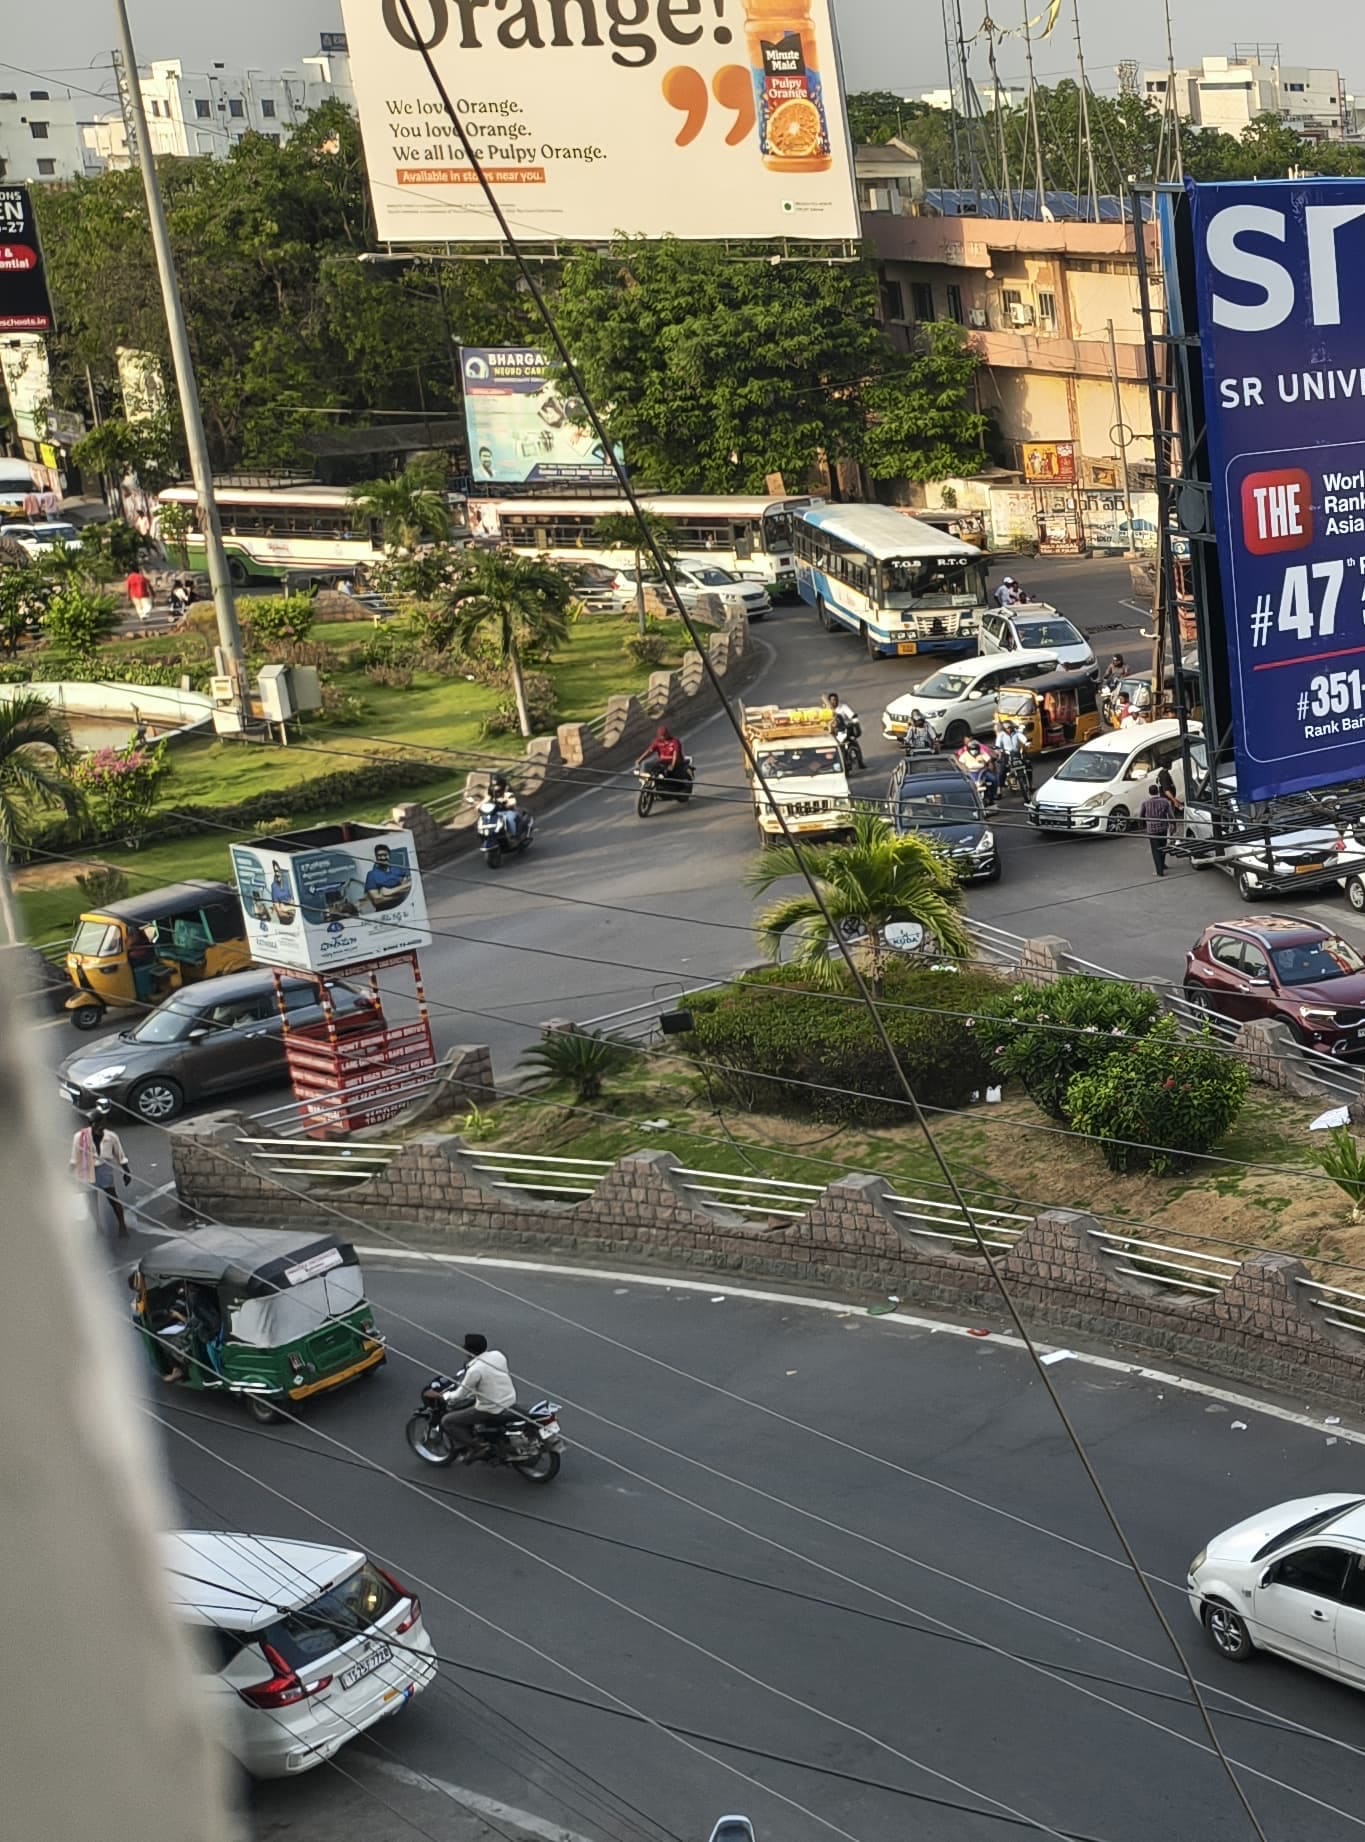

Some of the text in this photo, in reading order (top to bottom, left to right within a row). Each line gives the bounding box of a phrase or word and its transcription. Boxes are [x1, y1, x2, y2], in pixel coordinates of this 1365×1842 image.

[381, 0, 734, 68] Orange!
[766, 50, 800, 62] Minute
[771, 60, 798, 71] Maid
[769, 88, 809, 99] Orange
[771, 78, 803, 91] Pulpy
[386, 100, 413, 115] We
[457, 98, 524, 116] Orange.
[389, 123, 422, 138] You
[465, 121, 532, 140] Orange.
[393, 143, 608, 163] We all loe Pulpy Orange.
[402, 170, 449, 183] Available
[451, 170, 461, 182] in
[496, 172, 519, 182] near
[520, 171, 544, 184] you.
[488, 353, 551, 367] BHARGA
[1220, 377, 1264, 409] SR
[1252, 483, 1303, 541] THE
[1324, 514, 1365, 537] Asia
[1304, 719, 1340, 740] Rank
